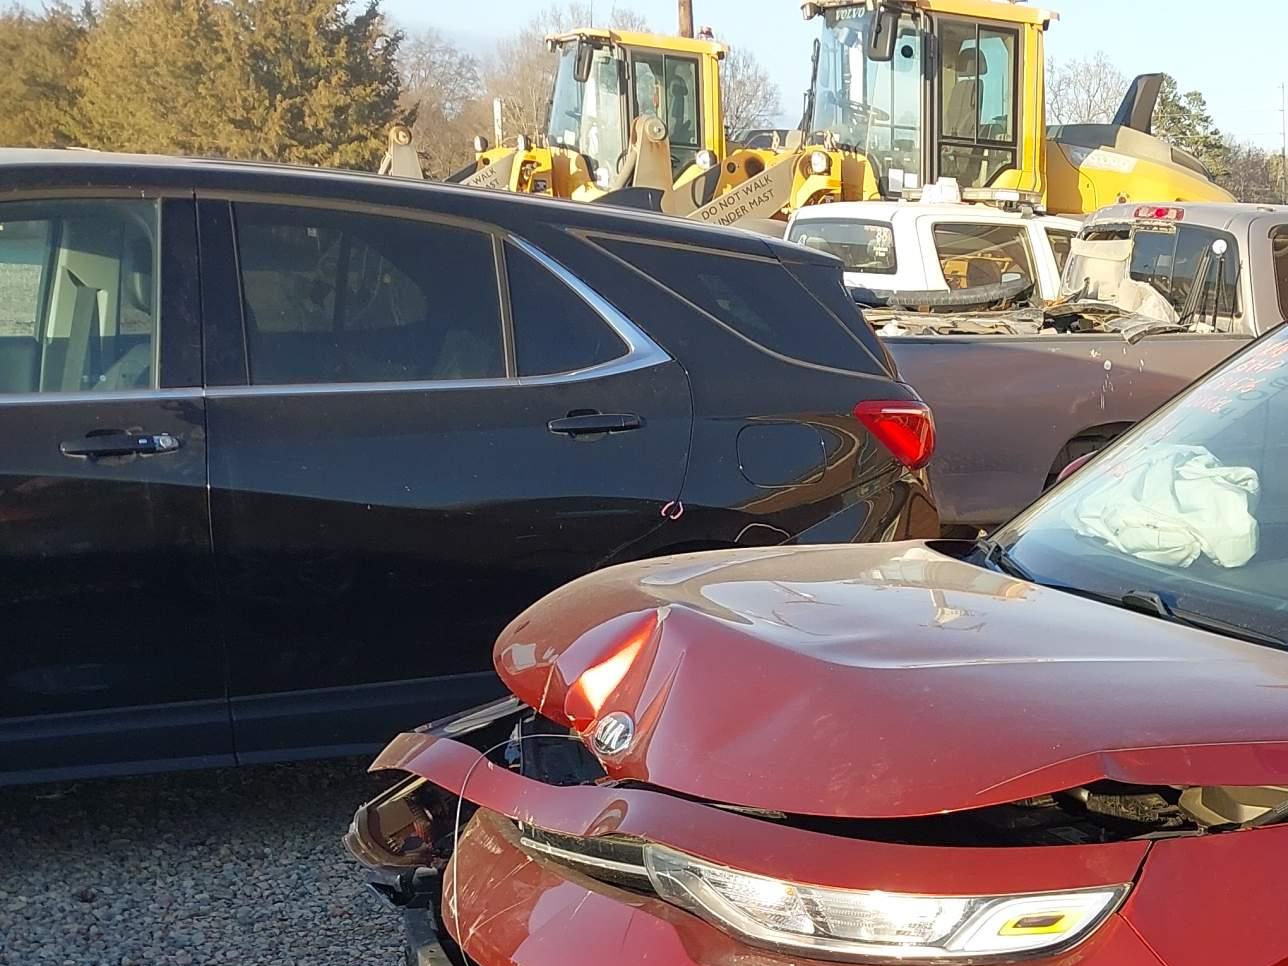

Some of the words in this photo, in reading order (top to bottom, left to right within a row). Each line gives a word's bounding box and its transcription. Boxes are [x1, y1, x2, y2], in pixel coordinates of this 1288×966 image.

[835, 7, 866, 20] VOLVO
[473, 167, 497, 185] WALK
[701, 206, 718, 220] DO
[718, 191, 742, 210] NOT
[742, 174, 773, 196] WALK
[748, 189, 775, 210] MAST
